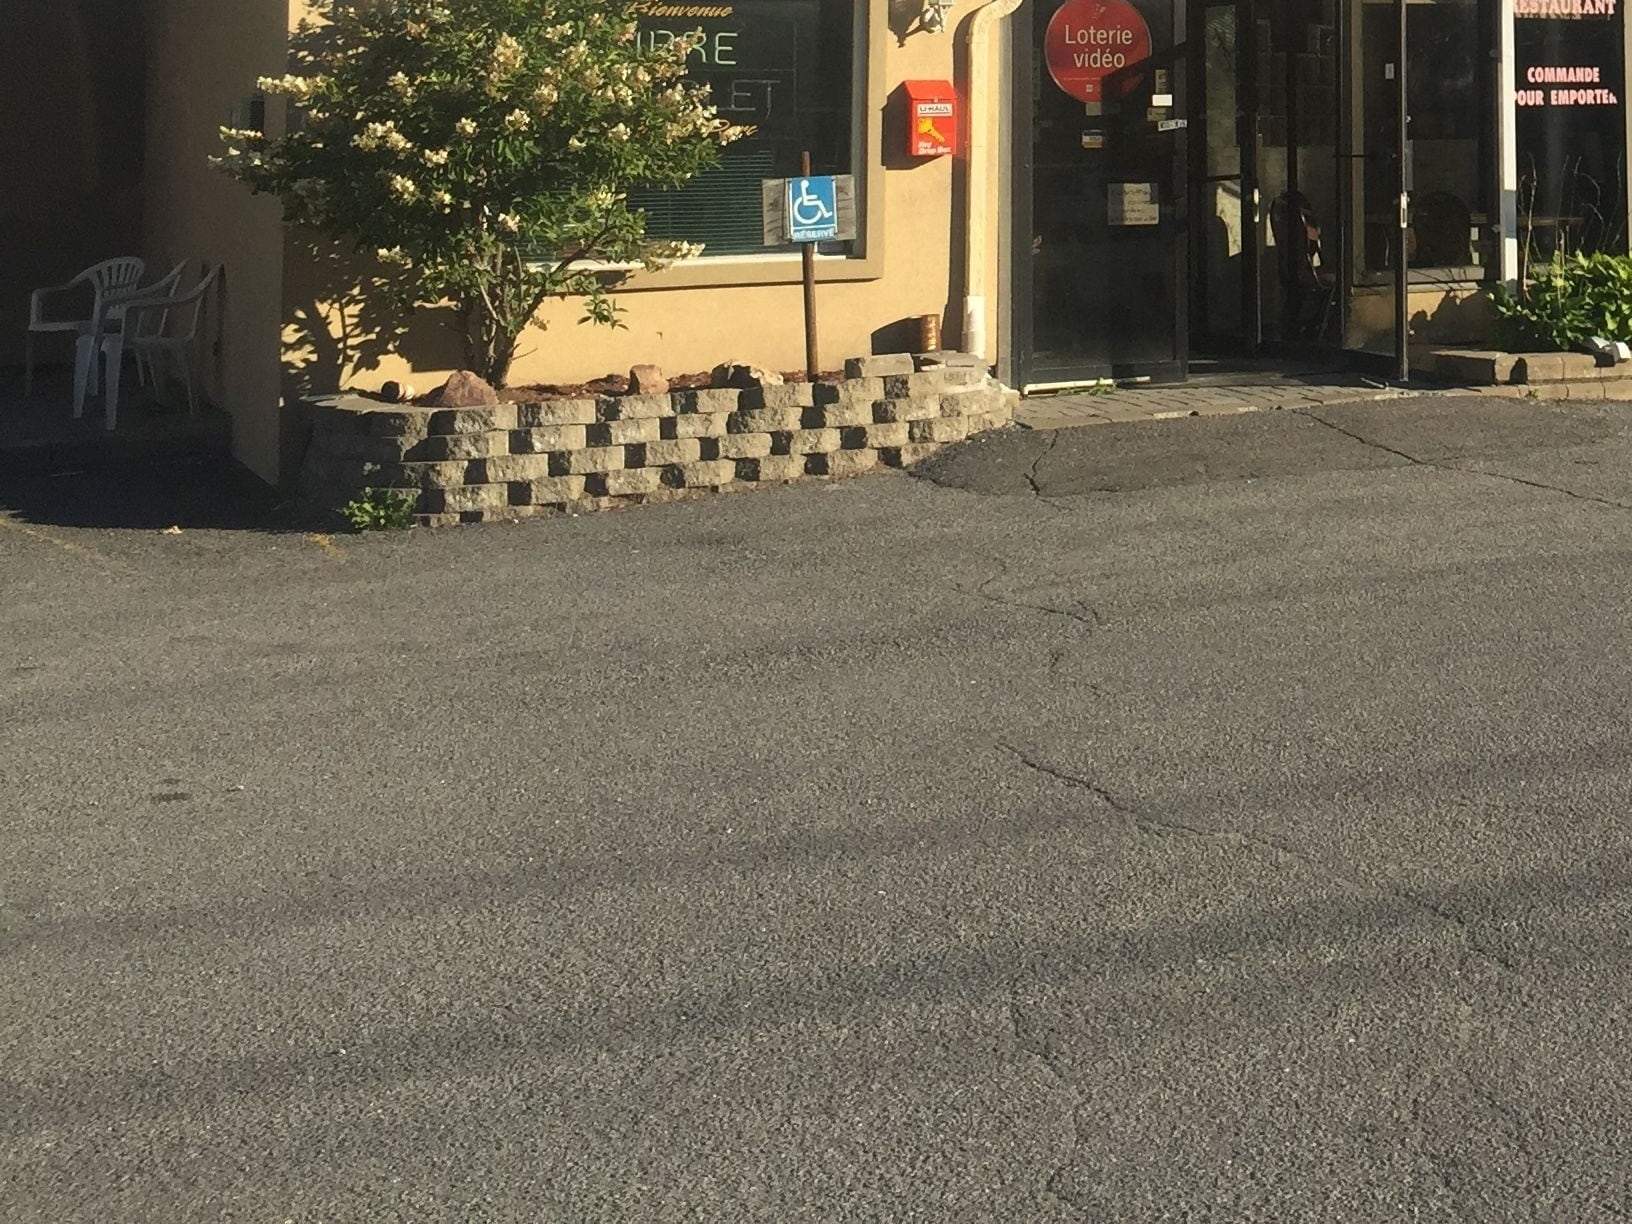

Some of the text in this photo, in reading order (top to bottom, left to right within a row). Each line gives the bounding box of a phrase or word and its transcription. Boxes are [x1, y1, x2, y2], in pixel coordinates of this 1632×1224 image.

[1064, 24, 1133, 45] Loterie
[1073, 48, 1126, 68] vidéo
[1527, 66, 1601, 83] COMMANDE
